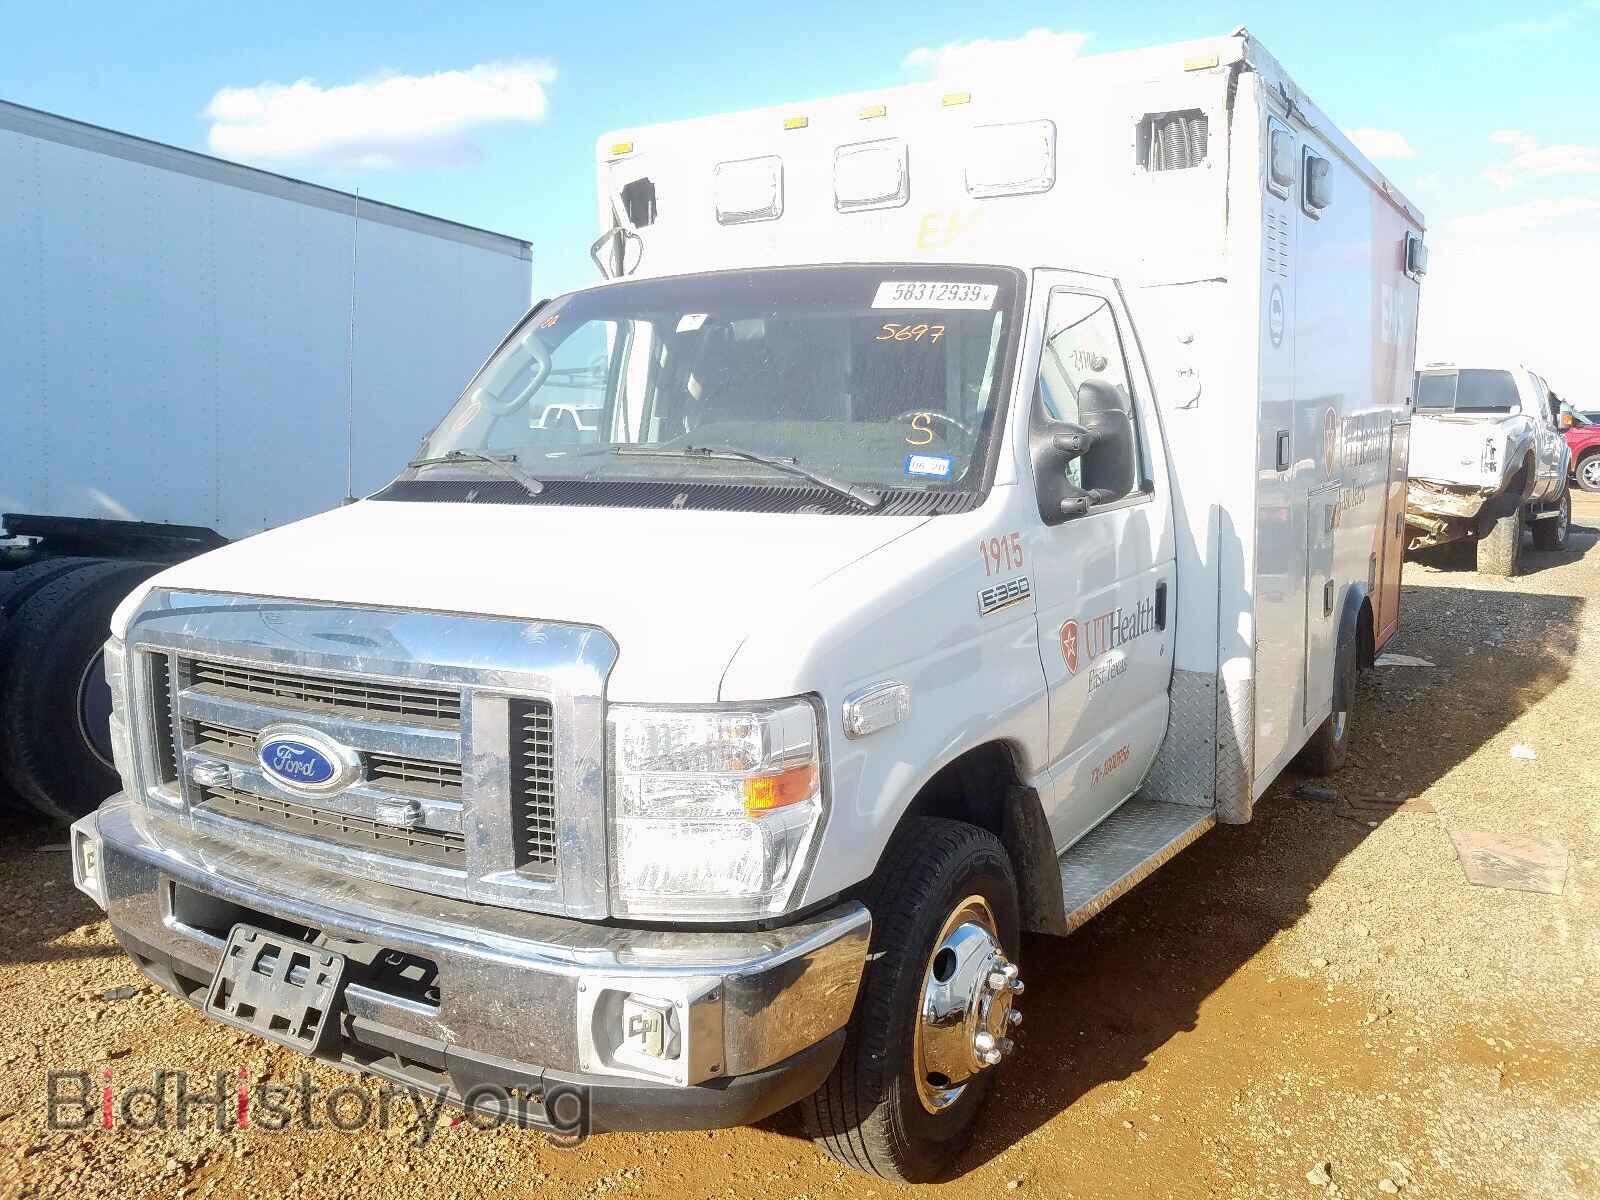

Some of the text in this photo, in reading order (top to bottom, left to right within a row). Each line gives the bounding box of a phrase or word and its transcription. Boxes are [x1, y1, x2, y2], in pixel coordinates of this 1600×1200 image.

[892, 283, 982, 301] 58312939
[876, 323, 945, 343] 5697
[905, 413, 933, 445] S
[979, 532, 1024, 576] 1915
[273, 745, 317, 777] Ford
